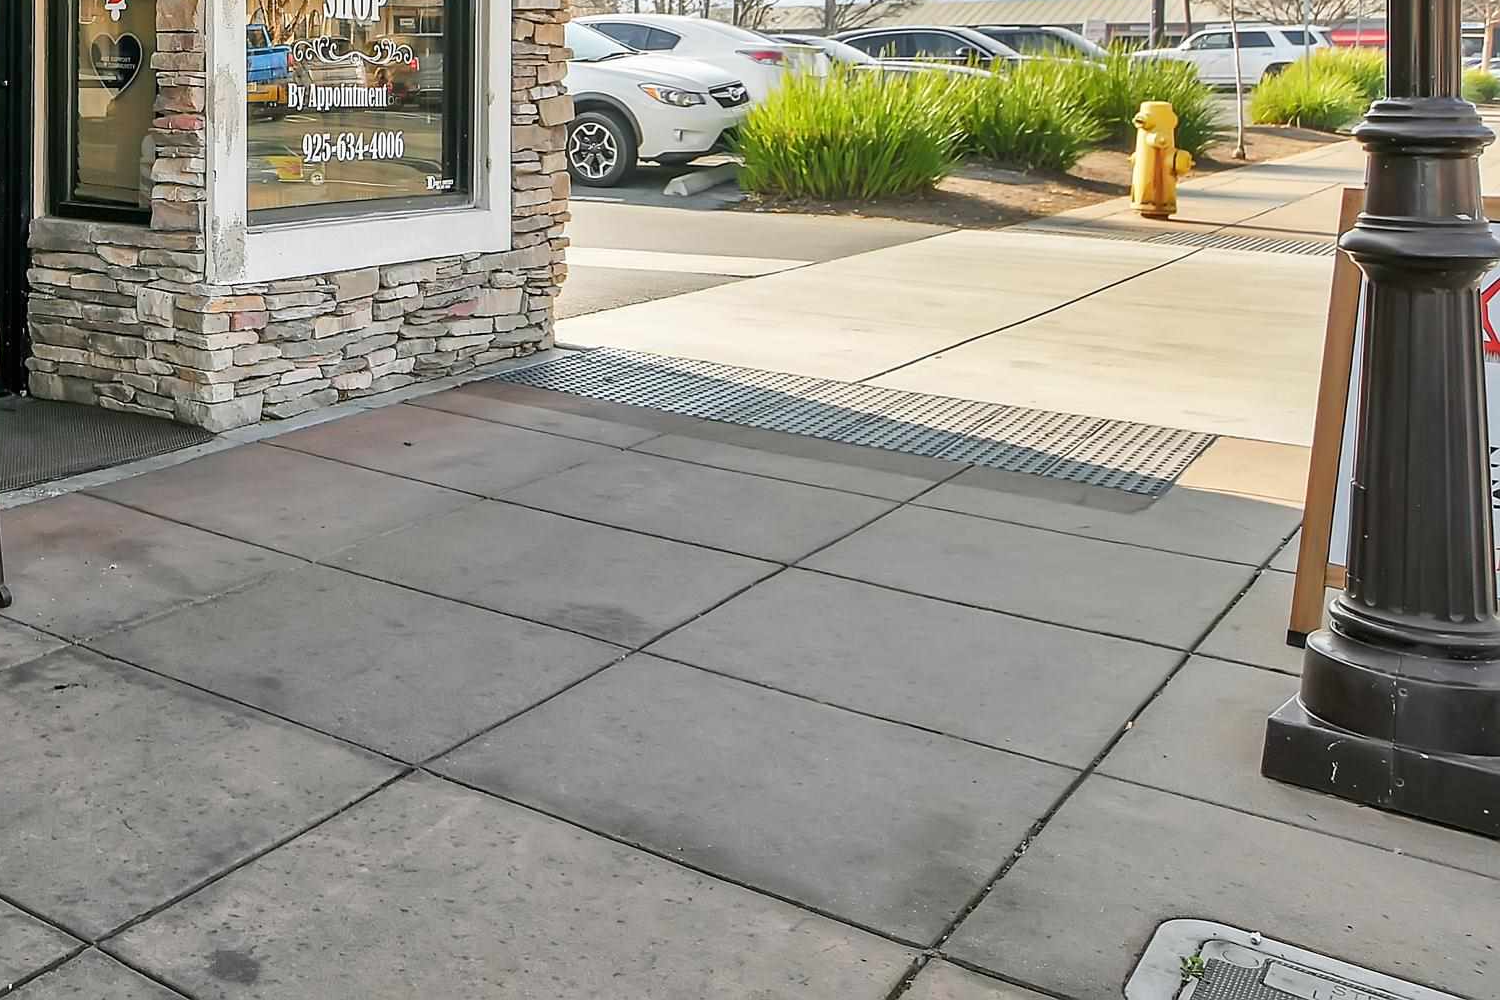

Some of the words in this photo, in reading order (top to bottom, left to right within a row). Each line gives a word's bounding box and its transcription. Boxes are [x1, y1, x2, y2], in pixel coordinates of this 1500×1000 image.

[287, 83, 306, 111] By
[308, 83, 388, 111] Appointment
[301, 130, 405, 162] 925-634-4006
